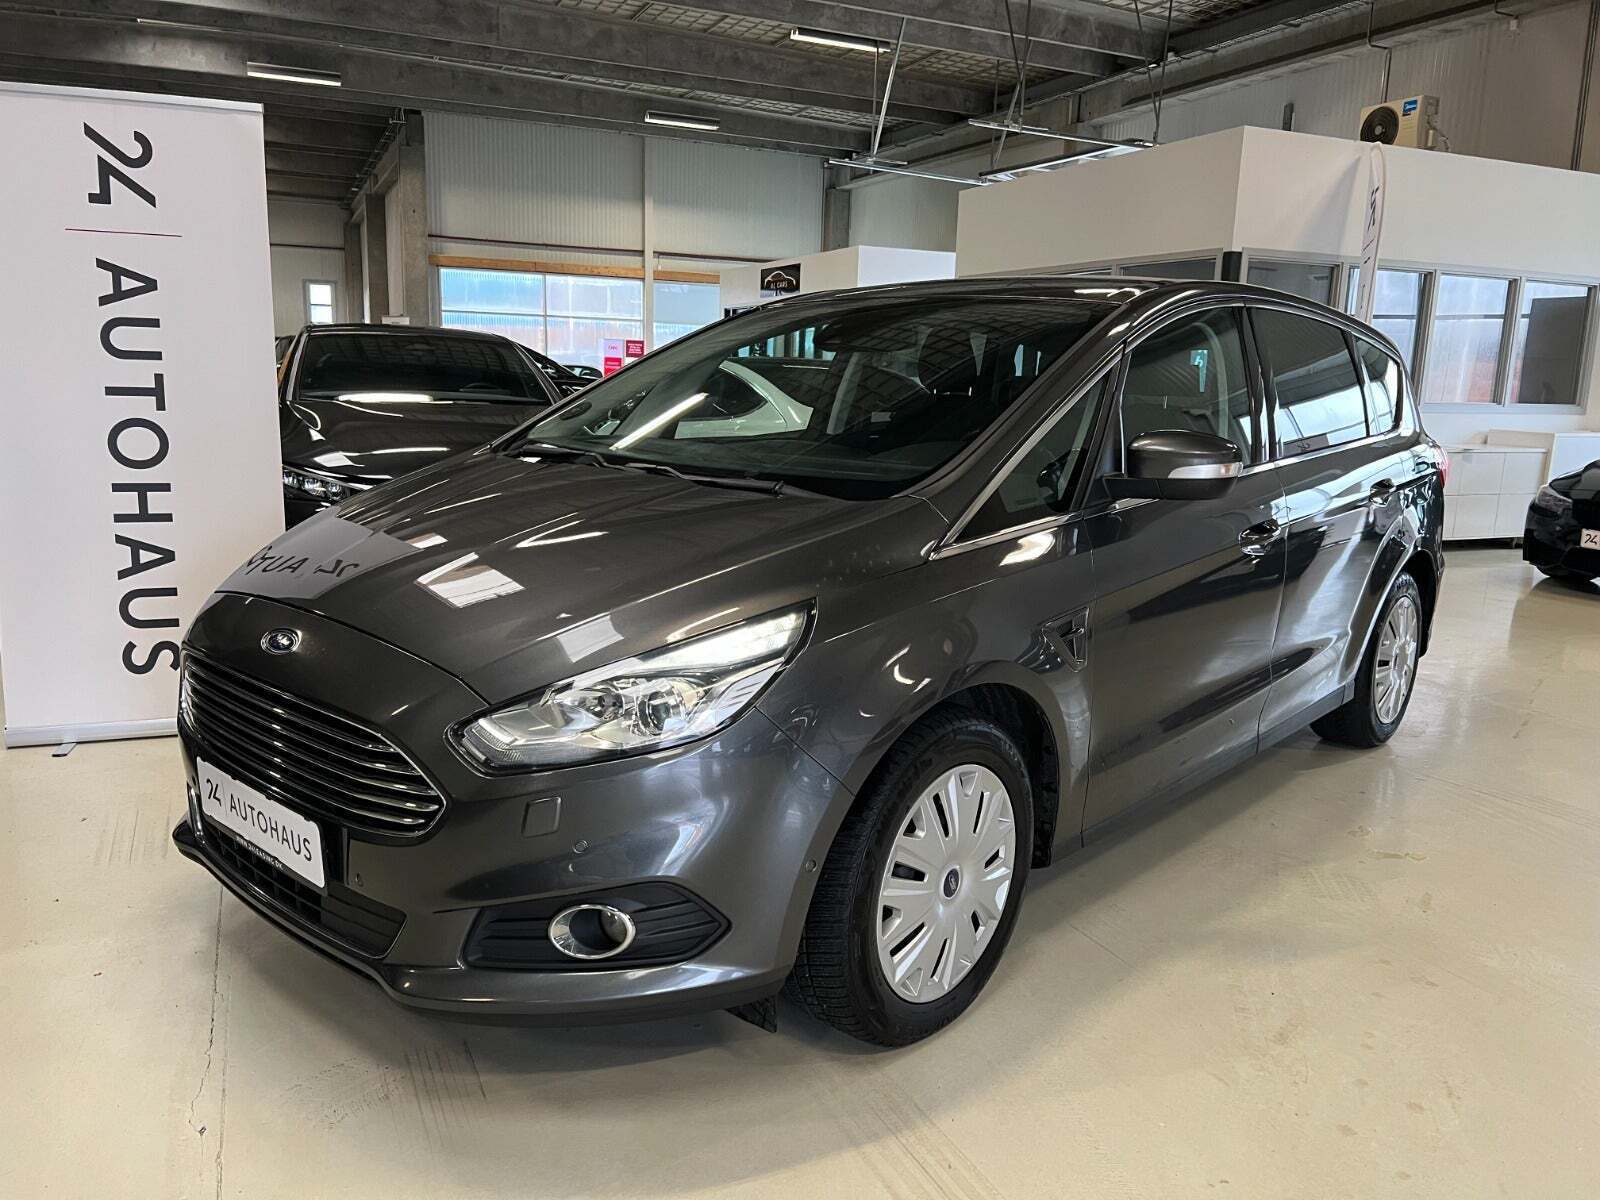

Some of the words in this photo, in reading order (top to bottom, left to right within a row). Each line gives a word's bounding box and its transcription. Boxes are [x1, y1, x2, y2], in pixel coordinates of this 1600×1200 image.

[83, 121, 157, 209] 24
[95, 257, 180, 675] AUTOHAUS
[1585, 533, 1598, 546] 24
[206, 778, 222, 807] 24
[229, 793, 313, 862] AUTOHAUS
